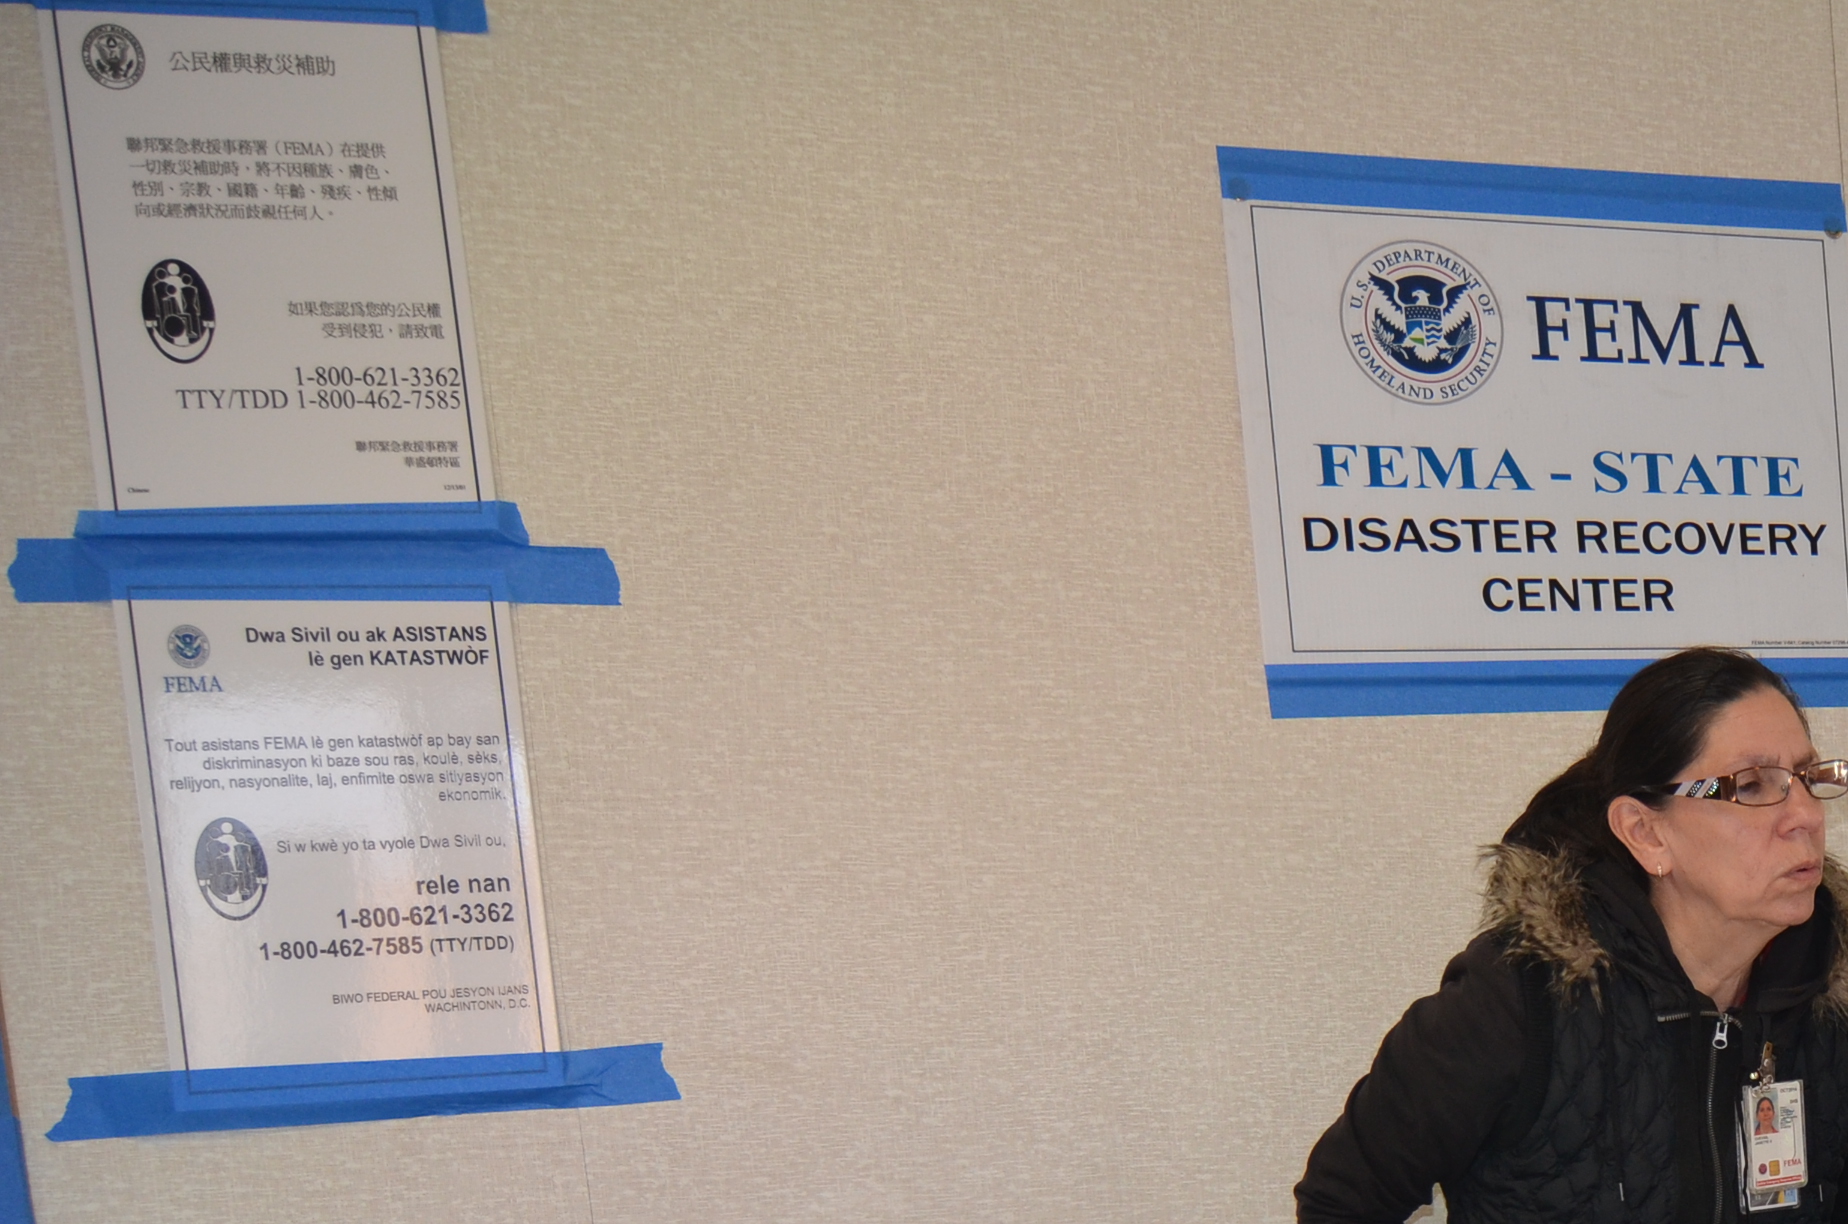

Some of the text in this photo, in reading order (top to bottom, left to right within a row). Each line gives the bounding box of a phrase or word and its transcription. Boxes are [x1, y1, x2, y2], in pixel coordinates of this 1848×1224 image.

[169, 51, 336, 77] 公民權與救災補助
[1350, 249, 1495, 316] U.S. DEPARTMENT OF
[1526, 294, 1764, 369] FEMA
[295, 366, 461, 387] 1-800-621-3362
[1351, 333, 1497, 400] HOMELAND SECURITY
[175, 389, 461, 410] TTY/TDD 1-800-462-7585
[1312, 442, 1535, 491] FEMA
[1592, 450, 1804, 497] STATE
[1302, 516, 1827, 556] DISASTER RECOVERY
[1481, 578, 1675, 613] CENTER
[245, 626, 488, 644] Dwa Sivil ou ak ASISTANS
[308, 647, 490, 671] lè gen KATASTWÒF
[163, 675, 224, 694] FEMA
[165, 733, 500, 752] Tout asistans FEMA lè gen katastwòf ap bay san
[202, 756, 307, 772] diskriminasyon
[310, 754, 323, 768] ki
[327, 754, 360, 768] baze
[364, 755, 389, 766] sou
[393, 754, 418, 768] ras,
[423, 752, 463, 766] koulè,
[170, 776, 225, 793] relijyon,
[228, 774, 313, 791] nasyonalite,
[316, 773, 337, 789] laj,
[341, 771, 395, 786] enfimite
[398, 773, 434, 784] oswa
[438, 788, 506, 802] ekonomik.
[276, 840, 292, 854] Si
[294, 842, 307, 853] w
[310, 838, 339, 852] kwè
[342, 841, 359, 855] yo
[362, 838, 376, 851] ta
[379, 836, 416, 854] vyole
[420, 835, 450, 849] Dwa
[454, 834, 482, 848] Sivil
[416, 876, 511, 896] rele nan
[336, 902, 515, 929] 1-800-621-3362
[259, 935, 515, 961] 1-800-462-7585 (TTY/TDD)
[332, 993, 363, 1005] BIWO
[366, 990, 420, 1003] FEDERAL
[422, 989, 447, 1000] POU
[450, 986, 496, 999] JESYON
[509, 998, 531, 1009] D.C.
[1783, 1159, 1802, 1168] FEMA
